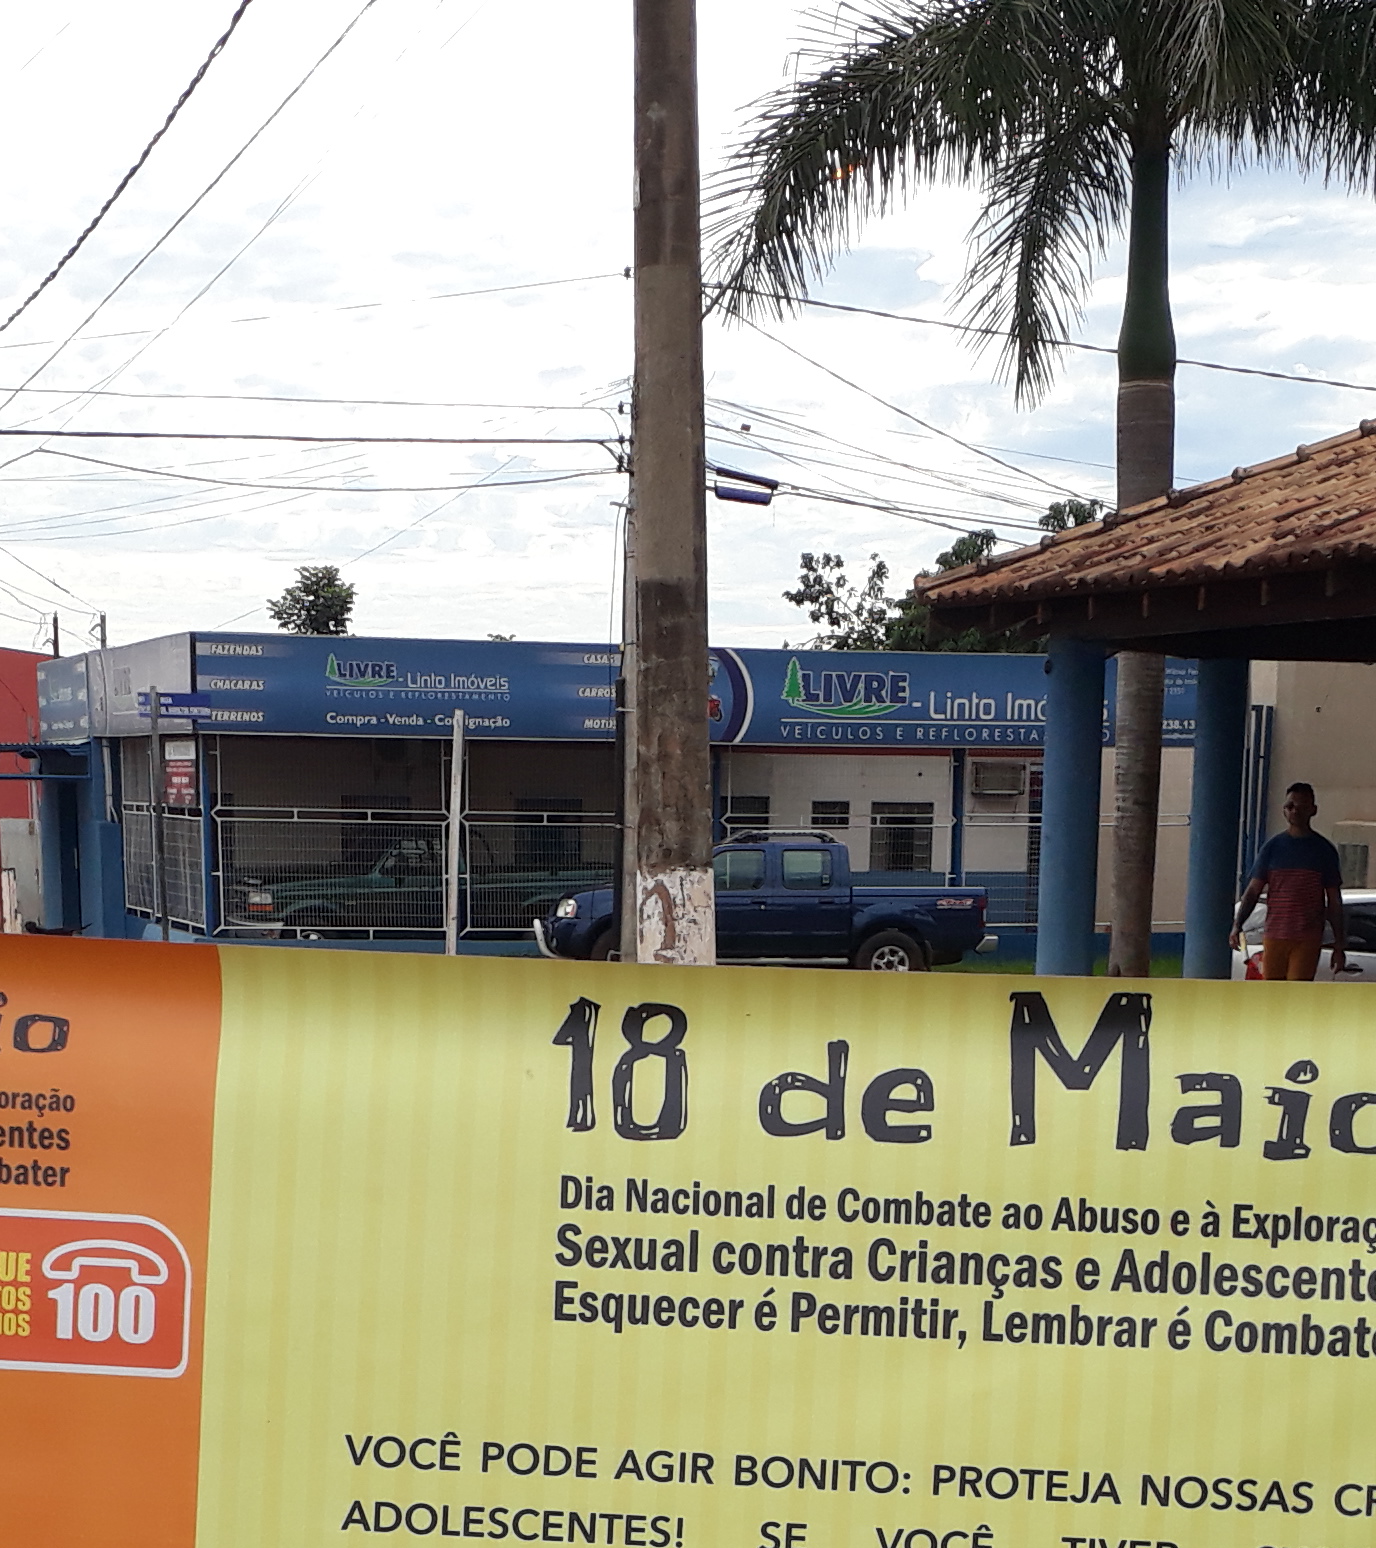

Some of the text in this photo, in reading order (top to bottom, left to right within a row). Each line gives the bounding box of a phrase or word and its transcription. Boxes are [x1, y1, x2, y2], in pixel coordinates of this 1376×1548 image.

[210, 645, 262, 655] FAZENDAS
[210, 680, 265, 690] CHACARAS
[337, 662, 509, 690] LIVRE Linto Imóveis
[802, 671, 996, 720] LIVRE Linto
[211, 710, 264, 721] TERRENOS
[326, 712, 424, 726] Compra Venda
[781, 724, 883, 740] VEÍCULOS
[552, 996, 688, 1141] 18
[759, 1040, 934, 1143] de
[561, 1175, 614, 1211] Dia
[626, 1178, 775, 1218] Nacional
[786, 1186, 826, 1221] de
[838, 1188, 991, 1228] Combate
[1002, 1203, 1042, 1230] ao
[1051, 1197, 1159, 1235] Abuso
[1171, 1210, 1189, 1236] e
[1201, 1200, 1219, 1237] à
[555, 1224, 698, 1272] Sexual
[713, 1236, 852, 1279] contra
[868, 1238, 1062, 1299] Crianças
[1076, 1258, 1100, 1290] e
[48, 1284, 155, 1345] 100
[555, 1281, 744, 1333] Esquecer
[755, 1287, 777, 1331] é
[791, 1292, 966, 1349] Permitir,
[983, 1301, 1157, 1348] Lembrar
[1168, 1319, 1191, 1350] é
[345, 1432, 460, 1471] VOCÊ
[482, 1442, 597, 1478] PODE
[614, 1450, 714, 1484] AGIR
[735, 1455, 910, 1494] BONITO:
[933, 1465, 1121, 1504] PROTEJA
[1141, 1475, 1313, 1514] NOSSAS
[341, 1501, 683, 1548] ADOLESCENTES!
